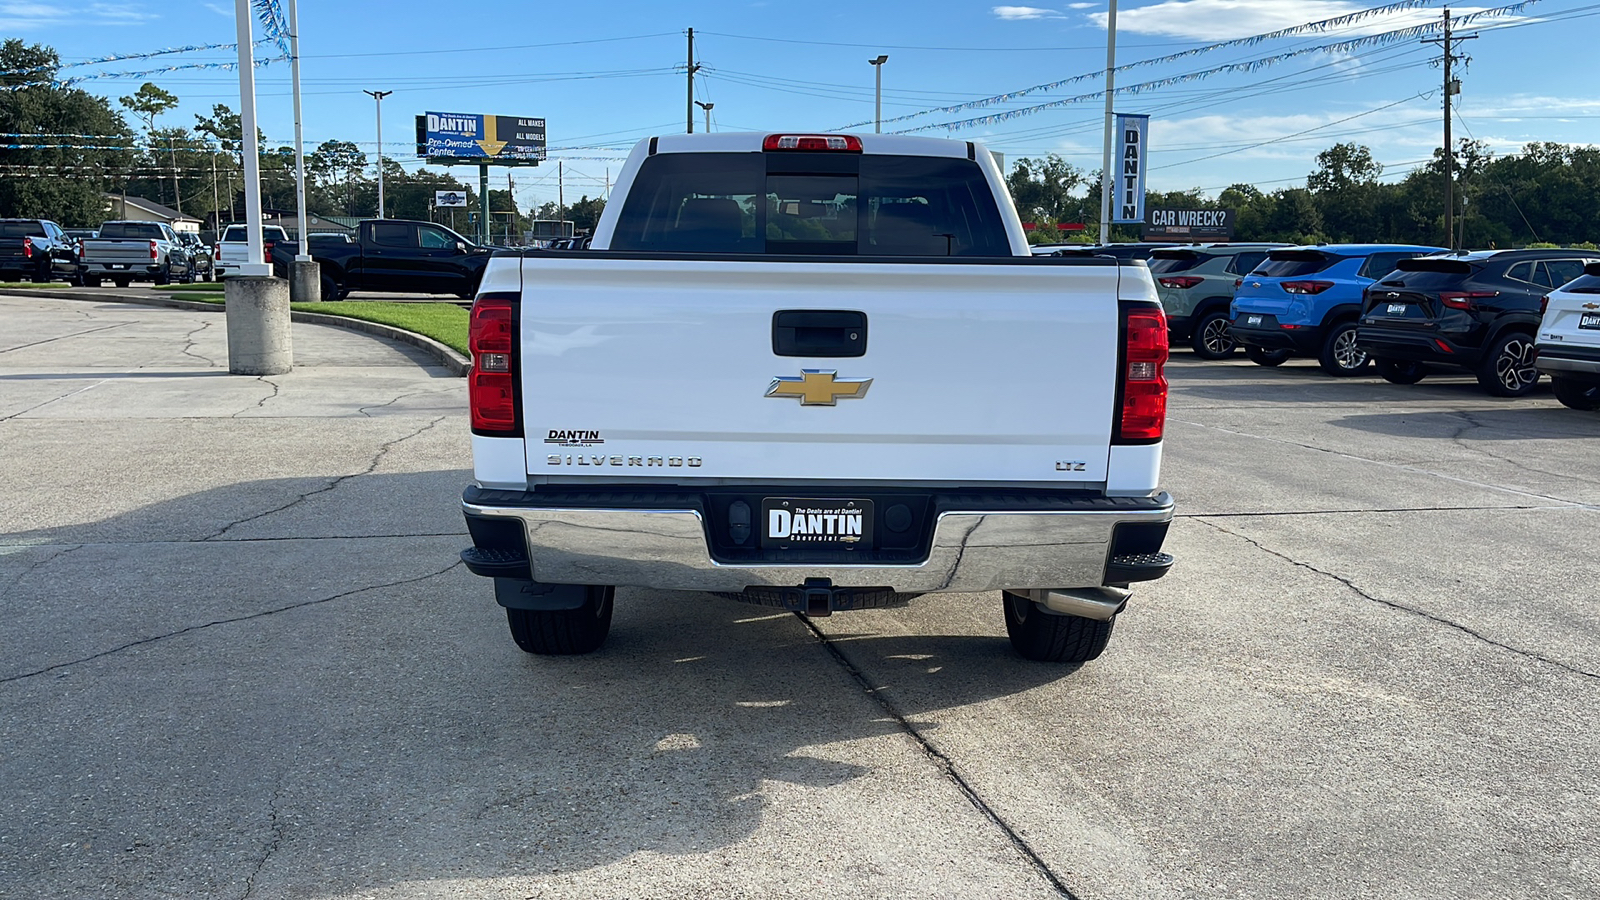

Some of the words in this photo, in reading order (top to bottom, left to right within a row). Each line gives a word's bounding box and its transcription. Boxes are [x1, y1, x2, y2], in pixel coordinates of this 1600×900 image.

[427, 114, 477, 132] DANTIN
[518, 119, 527, 127] ALL
[528, 120, 545, 128] MAKES
[516, 132, 525, 140] ALL
[526, 133, 545, 141] MODELS
[428, 138, 473, 148] Pre-Owned
[428, 147, 456, 157] Center
[1123, 130, 1138, 219] DANTIN
[1152, 210, 1176, 226] CAR
[1178, 210, 1227, 226] WRECK?
[548, 430, 599, 439] DANTIN
[547, 454, 703, 468] SILVERADO
[1055, 461, 1086, 472] LTZ
[768, 509, 863, 538] DANTIN
